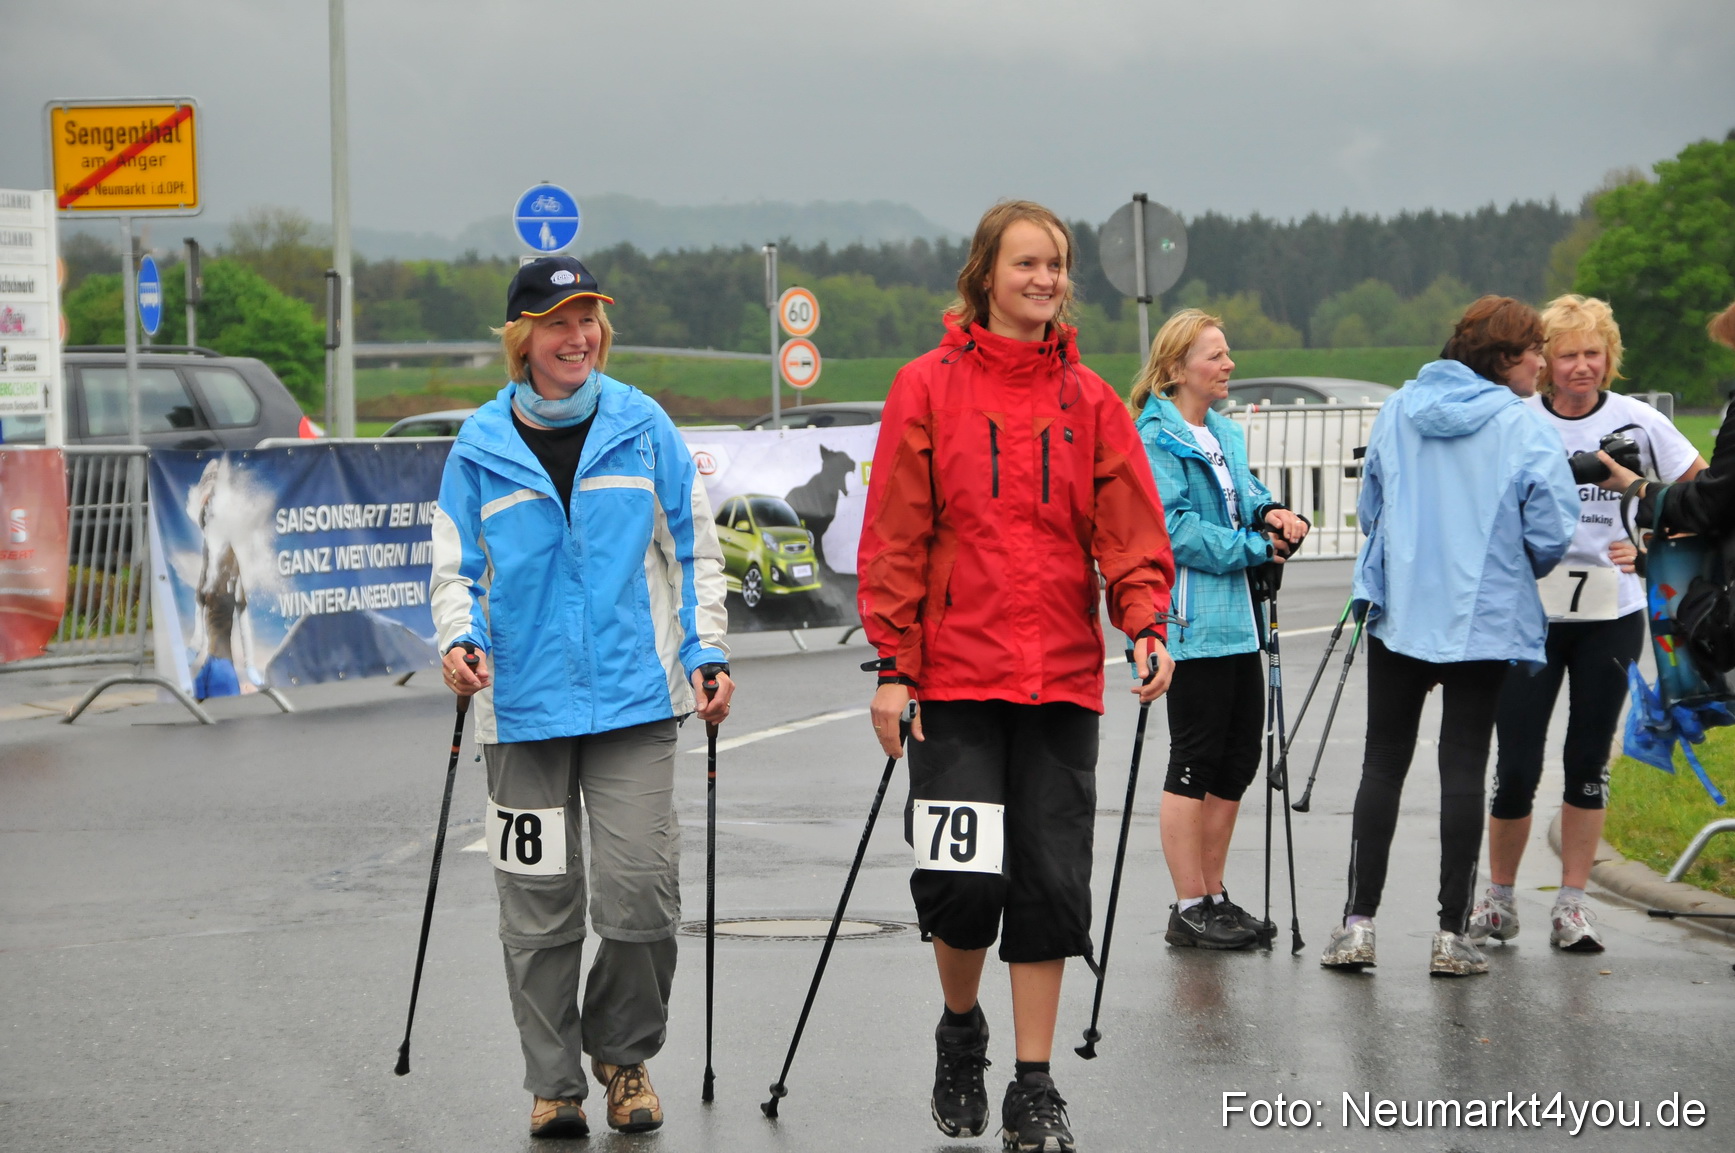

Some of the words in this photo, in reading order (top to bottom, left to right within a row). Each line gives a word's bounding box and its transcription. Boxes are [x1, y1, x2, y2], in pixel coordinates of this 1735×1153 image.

[64, 119, 182, 151] Sengenthal
[81, 156, 107, 169] am
[115, 153, 167, 171] Anger
[94, 182, 146, 196] Neumarkt
[788, 301, 810, 322] 60
[275, 503, 389, 534] SAISONSTART
[389, 502, 415, 528] BEI
[1581, 514, 1614, 527] talking
[277, 546, 332, 576] GANZ
[366, 542, 409, 568] VORN
[410, 540, 434, 565] MIT
[279, 581, 427, 618] WINTERANGEBOTEN
[1568, 571, 1589, 613] 7
[496, 809, 542, 866] 78
[928, 806, 978, 863] 79
